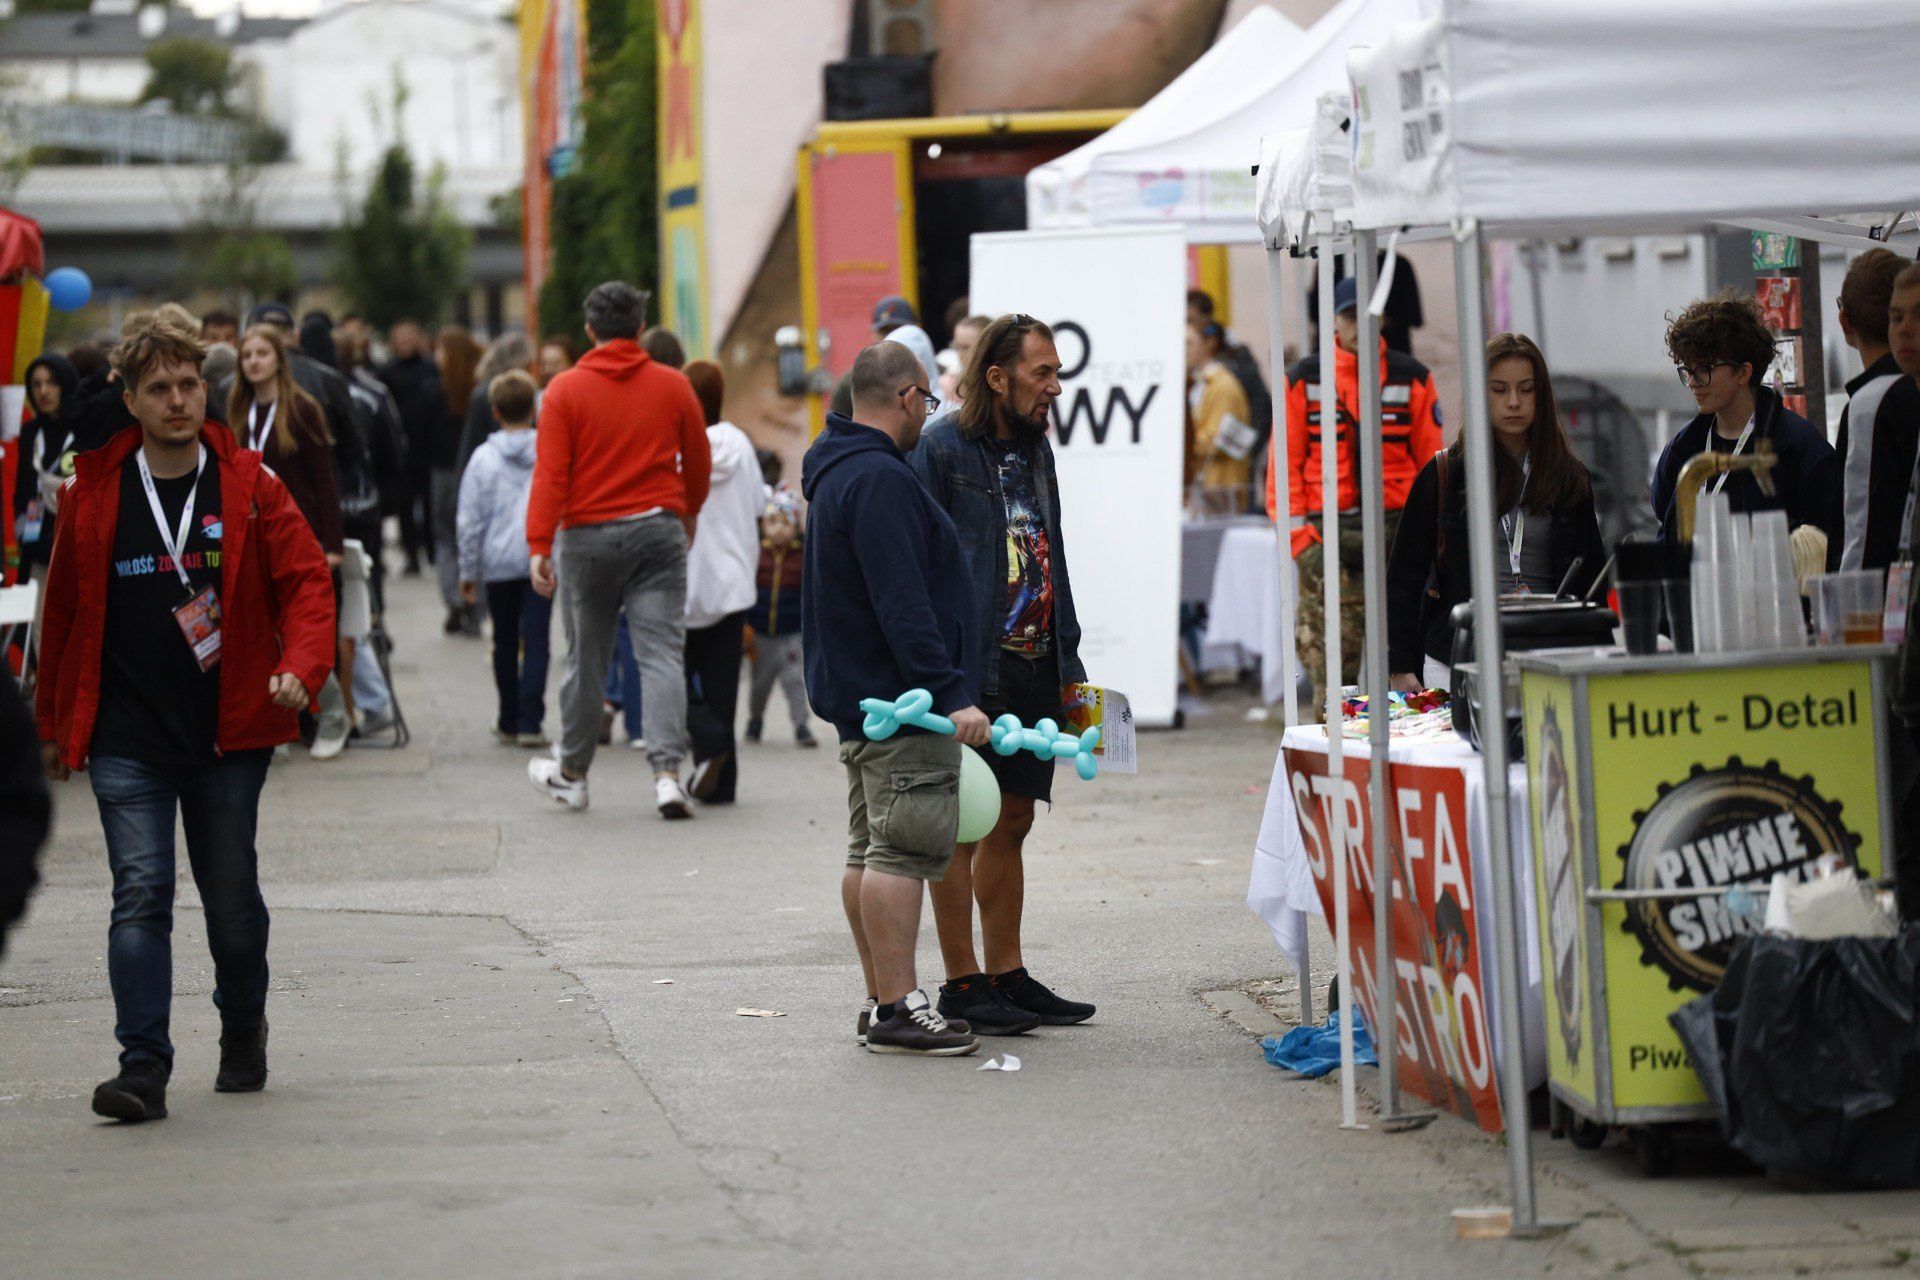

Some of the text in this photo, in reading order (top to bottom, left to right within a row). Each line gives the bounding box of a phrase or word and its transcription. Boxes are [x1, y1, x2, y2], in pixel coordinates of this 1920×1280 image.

[115, 551, 221, 577] MIŁOŚĆ ZOAJE TU
[1608, 701, 1702, 738] Hurt
[1742, 688, 1858, 732] Detal
[1292, 770, 1471, 911] STRFA
[1656, 812, 1808, 892] PIWNE
[1348, 946, 1489, 1091] STRO
